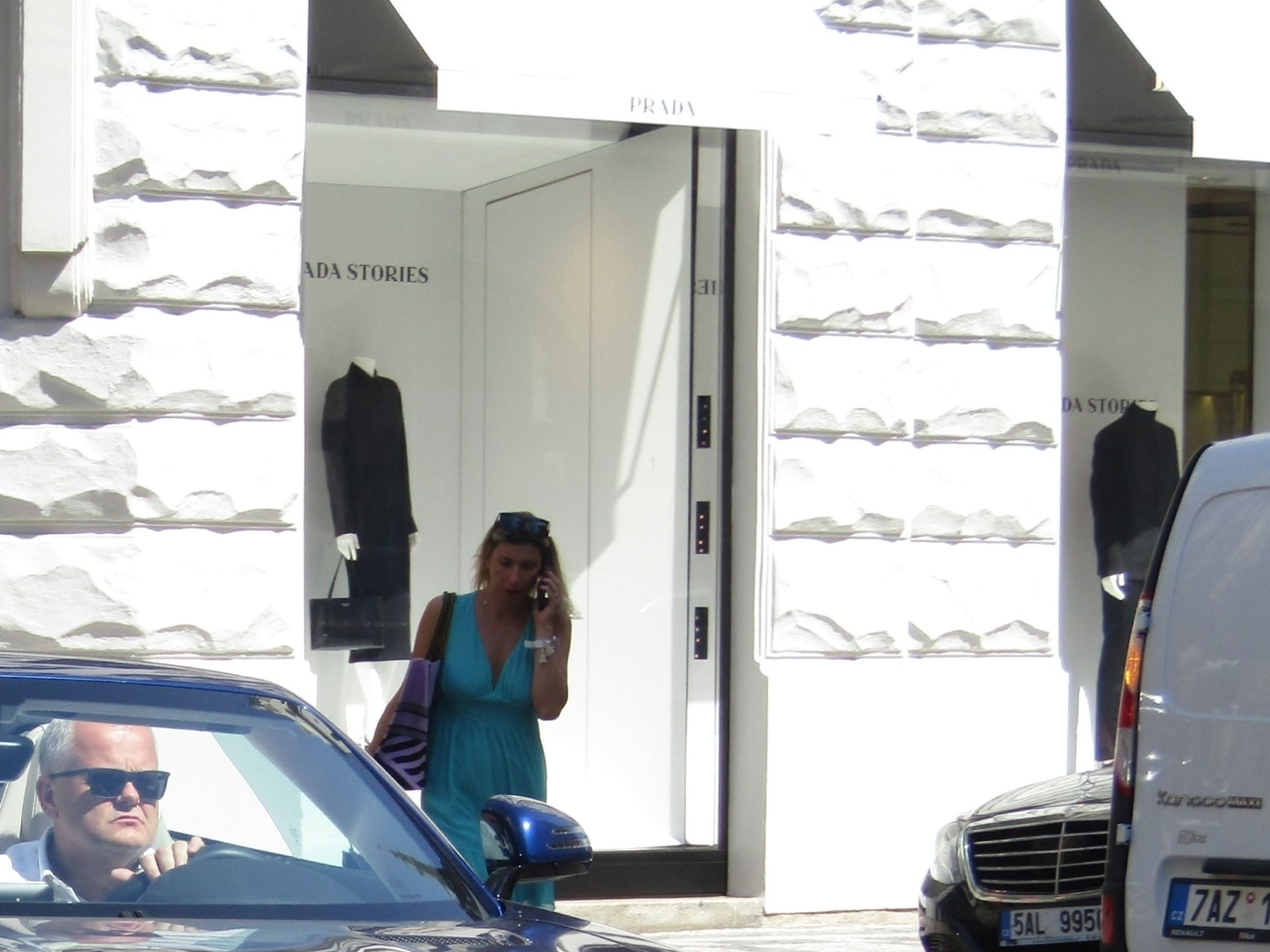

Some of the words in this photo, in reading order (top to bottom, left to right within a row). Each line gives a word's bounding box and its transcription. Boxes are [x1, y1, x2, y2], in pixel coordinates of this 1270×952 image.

[630, 96, 695, 116] PRADA
[347, 263, 429, 284] STORIES
[1170, 911, 1184, 921] CZ
[1191, 889, 1242, 923] 7AZ
[1013, 912, 1046, 936] 5AL
[1170, 929, 1205, 937] RENAULT
